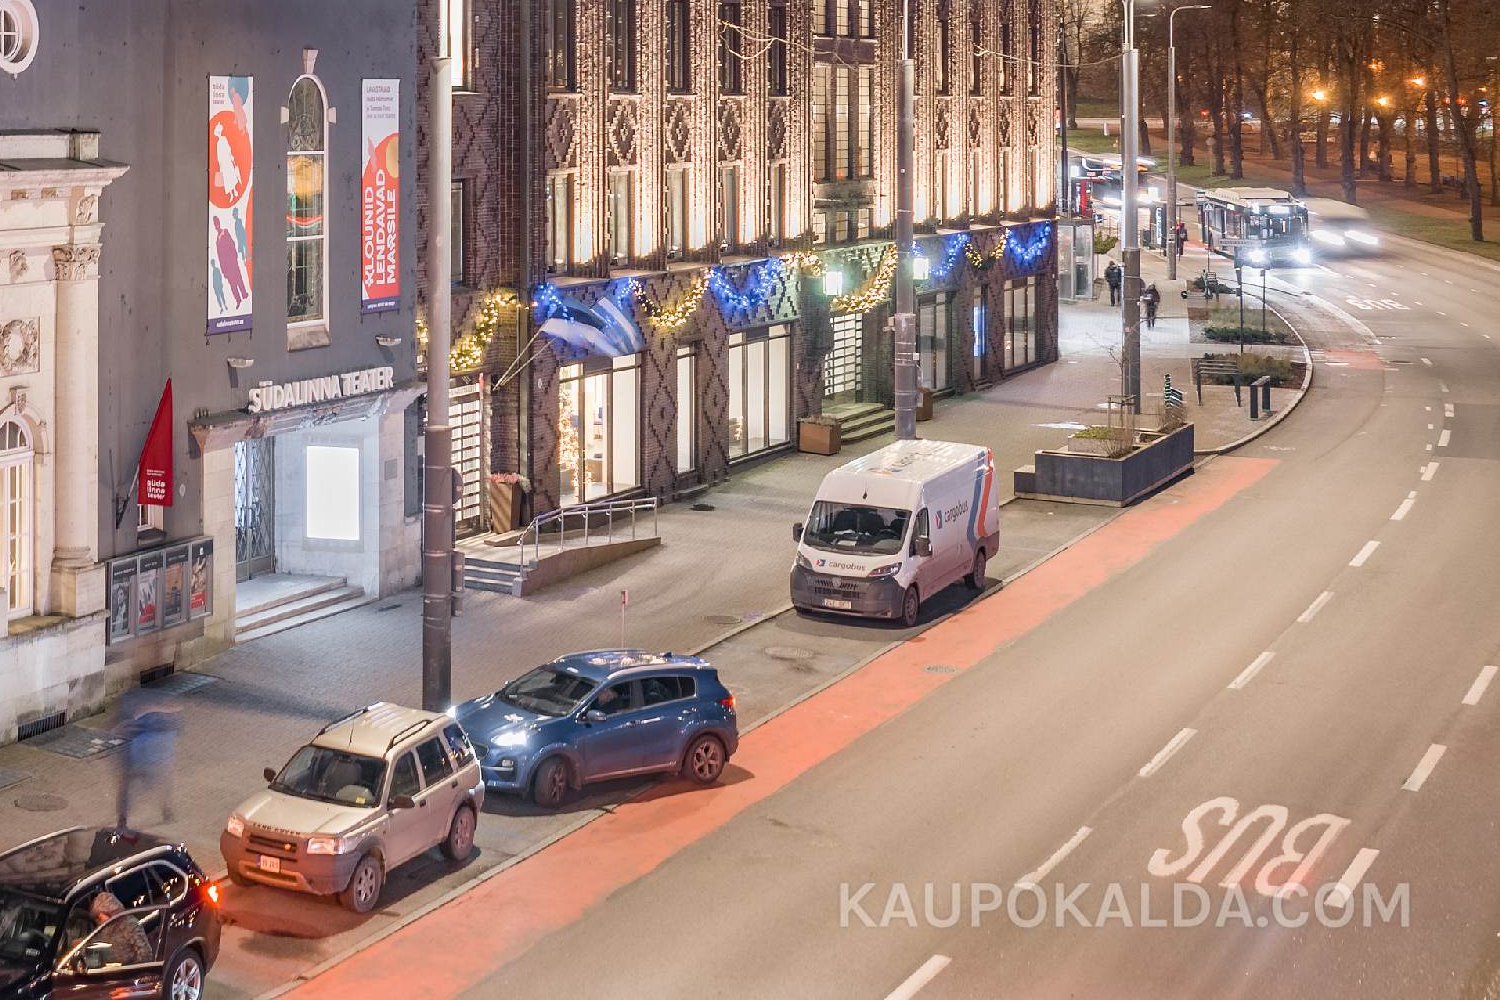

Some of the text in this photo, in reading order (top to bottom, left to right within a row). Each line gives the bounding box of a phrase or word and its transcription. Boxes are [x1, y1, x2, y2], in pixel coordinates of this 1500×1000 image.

[364, 187, 374, 287] KLOUNID
[376, 169, 386, 285] LENDAVAD
[386, 189, 396, 284] MARSILE
[248, 366, 394, 413] SÜDALINNA TEATER
[944, 500, 969, 523] cargobus
[1147, 796, 1352, 900] BUS
